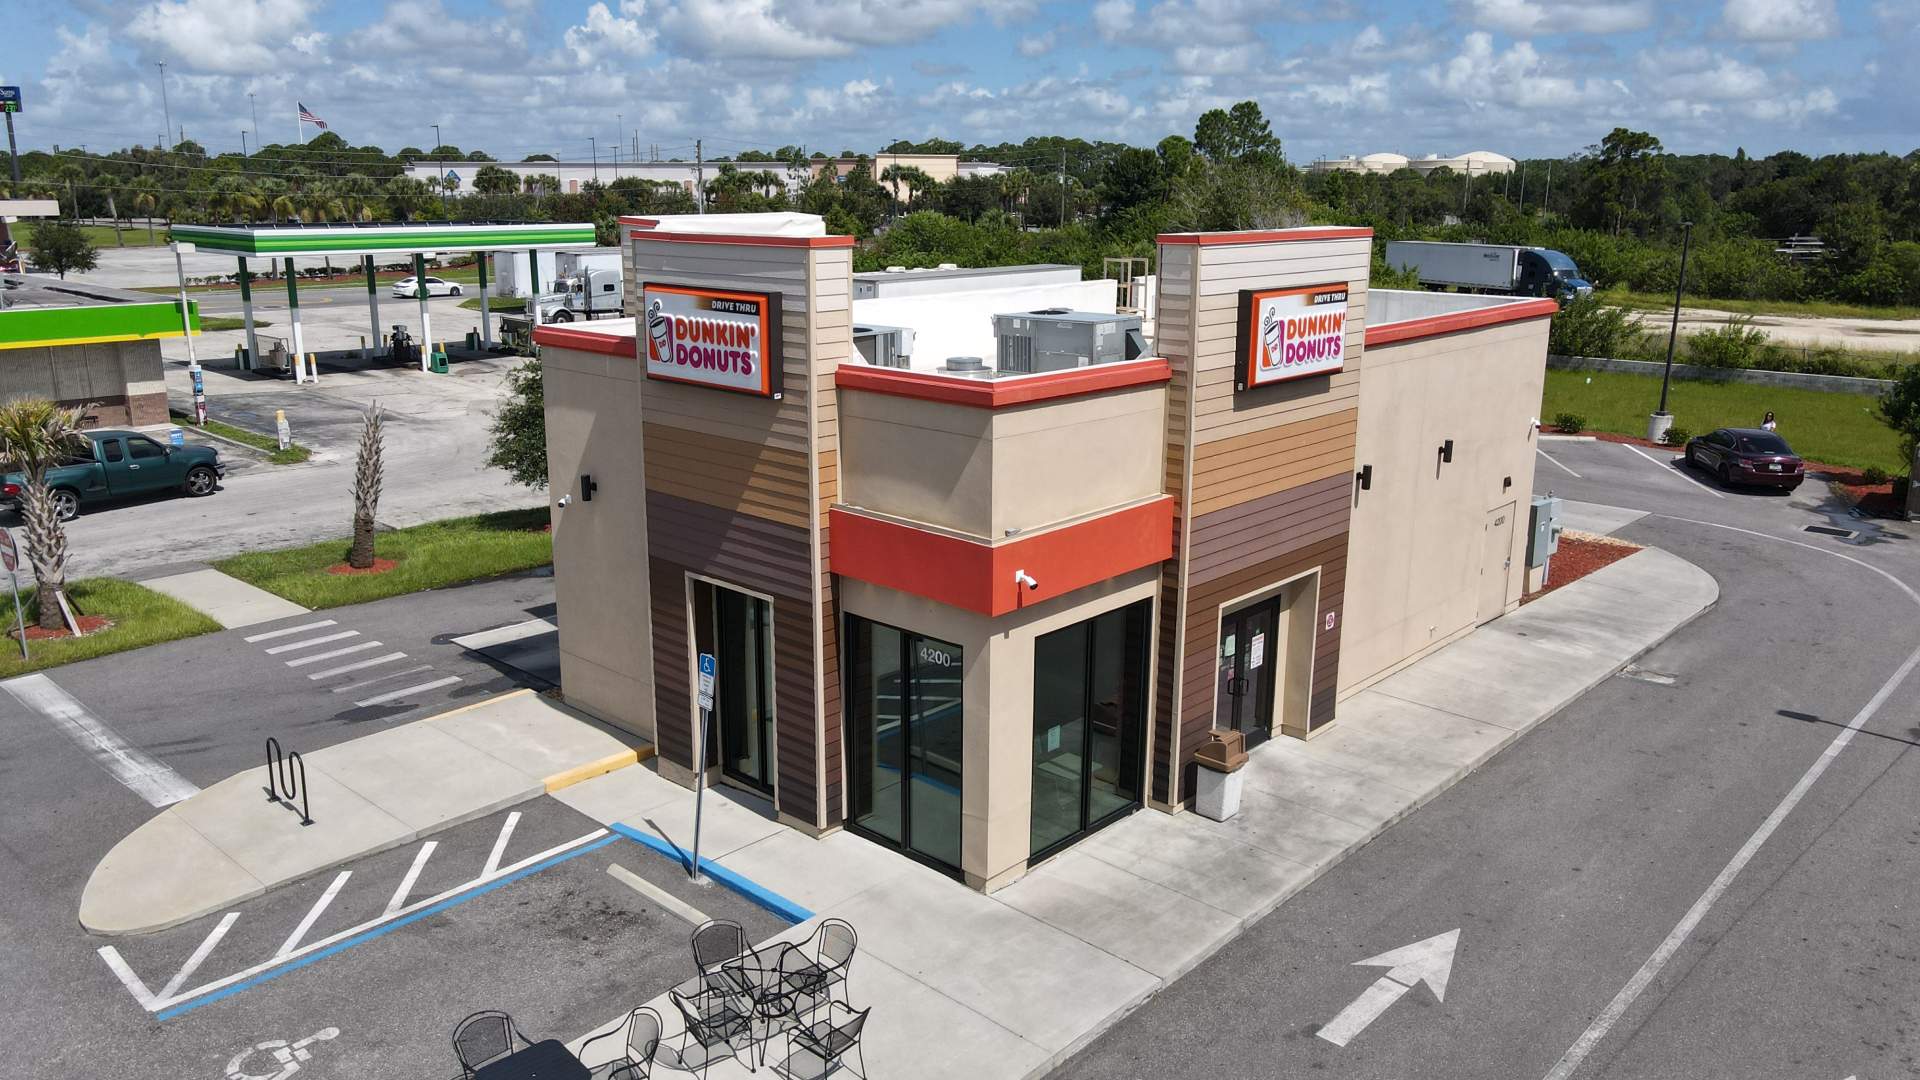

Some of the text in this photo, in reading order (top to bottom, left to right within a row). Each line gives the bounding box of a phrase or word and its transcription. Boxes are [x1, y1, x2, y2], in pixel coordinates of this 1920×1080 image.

[711, 300, 757, 313] DRIVE THRU
[1314, 292, 1346, 303] DRIVE THRU
[675, 318, 756, 349] DUNKIN'
[1286, 312, 1346, 340] DUNKIN'
[676, 343, 753, 375] DONUTS
[1285, 335, 1341, 365] DONUTS
[920, 647, 951, 667] 4200
